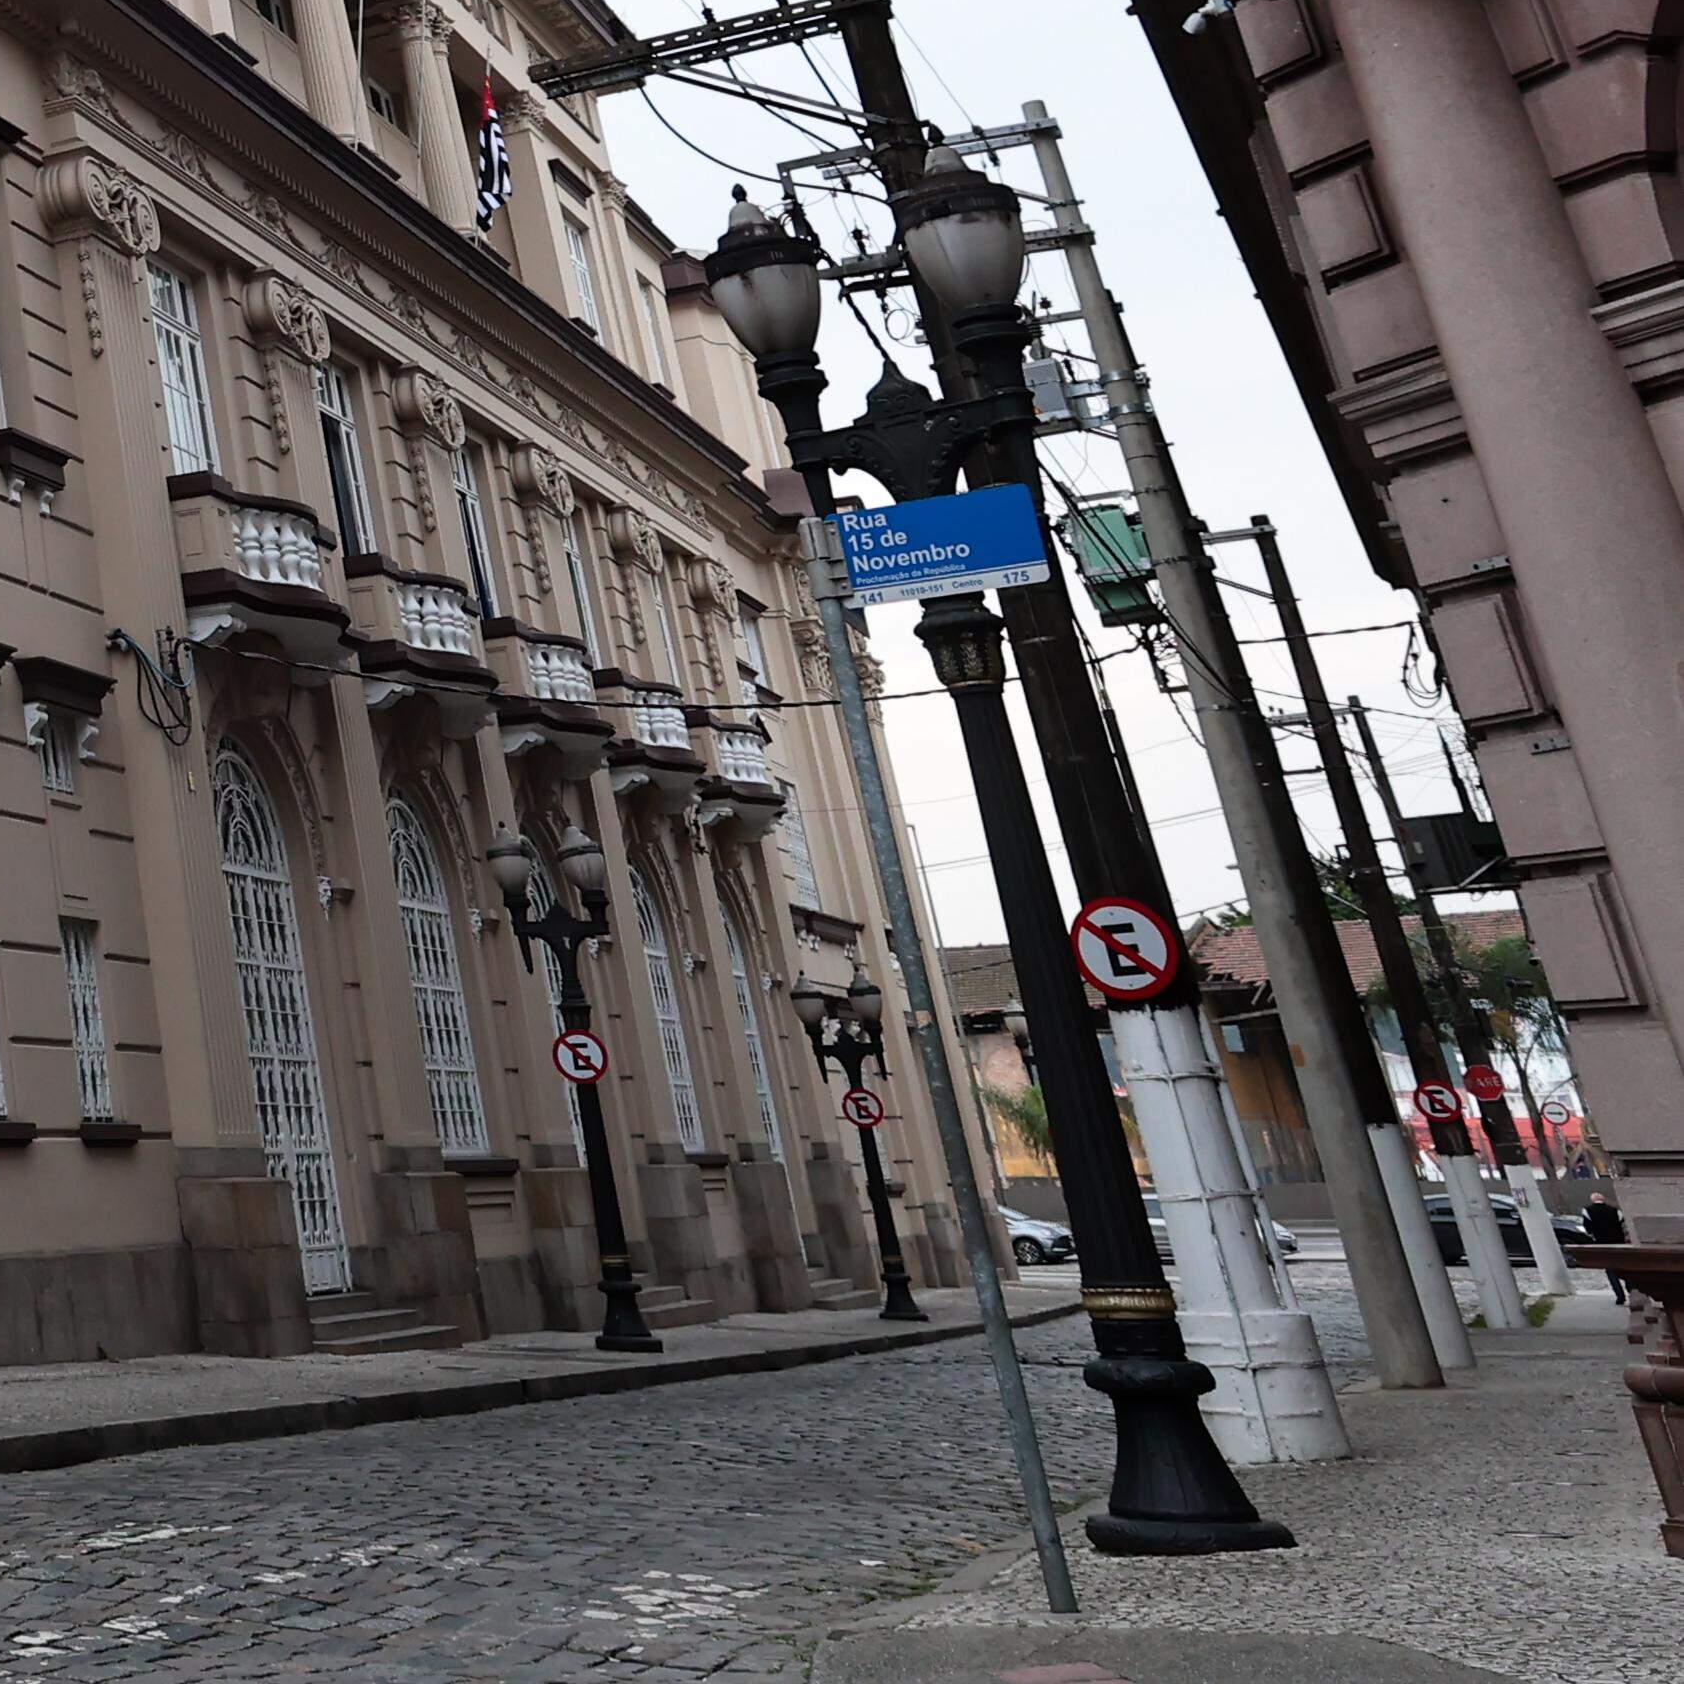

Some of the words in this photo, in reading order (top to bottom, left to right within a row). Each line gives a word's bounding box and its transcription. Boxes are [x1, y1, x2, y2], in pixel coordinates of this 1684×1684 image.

[842, 512, 888, 533] Rua
[848, 532, 874, 552] 15
[880, 529, 908, 548] de
[852, 542, 971, 574] Novembro
[860, 591, 884, 606] 141
[952, 578, 984, 589] Centro
[1002, 570, 1031, 585] 175
[1101, 923, 1146, 977] E
